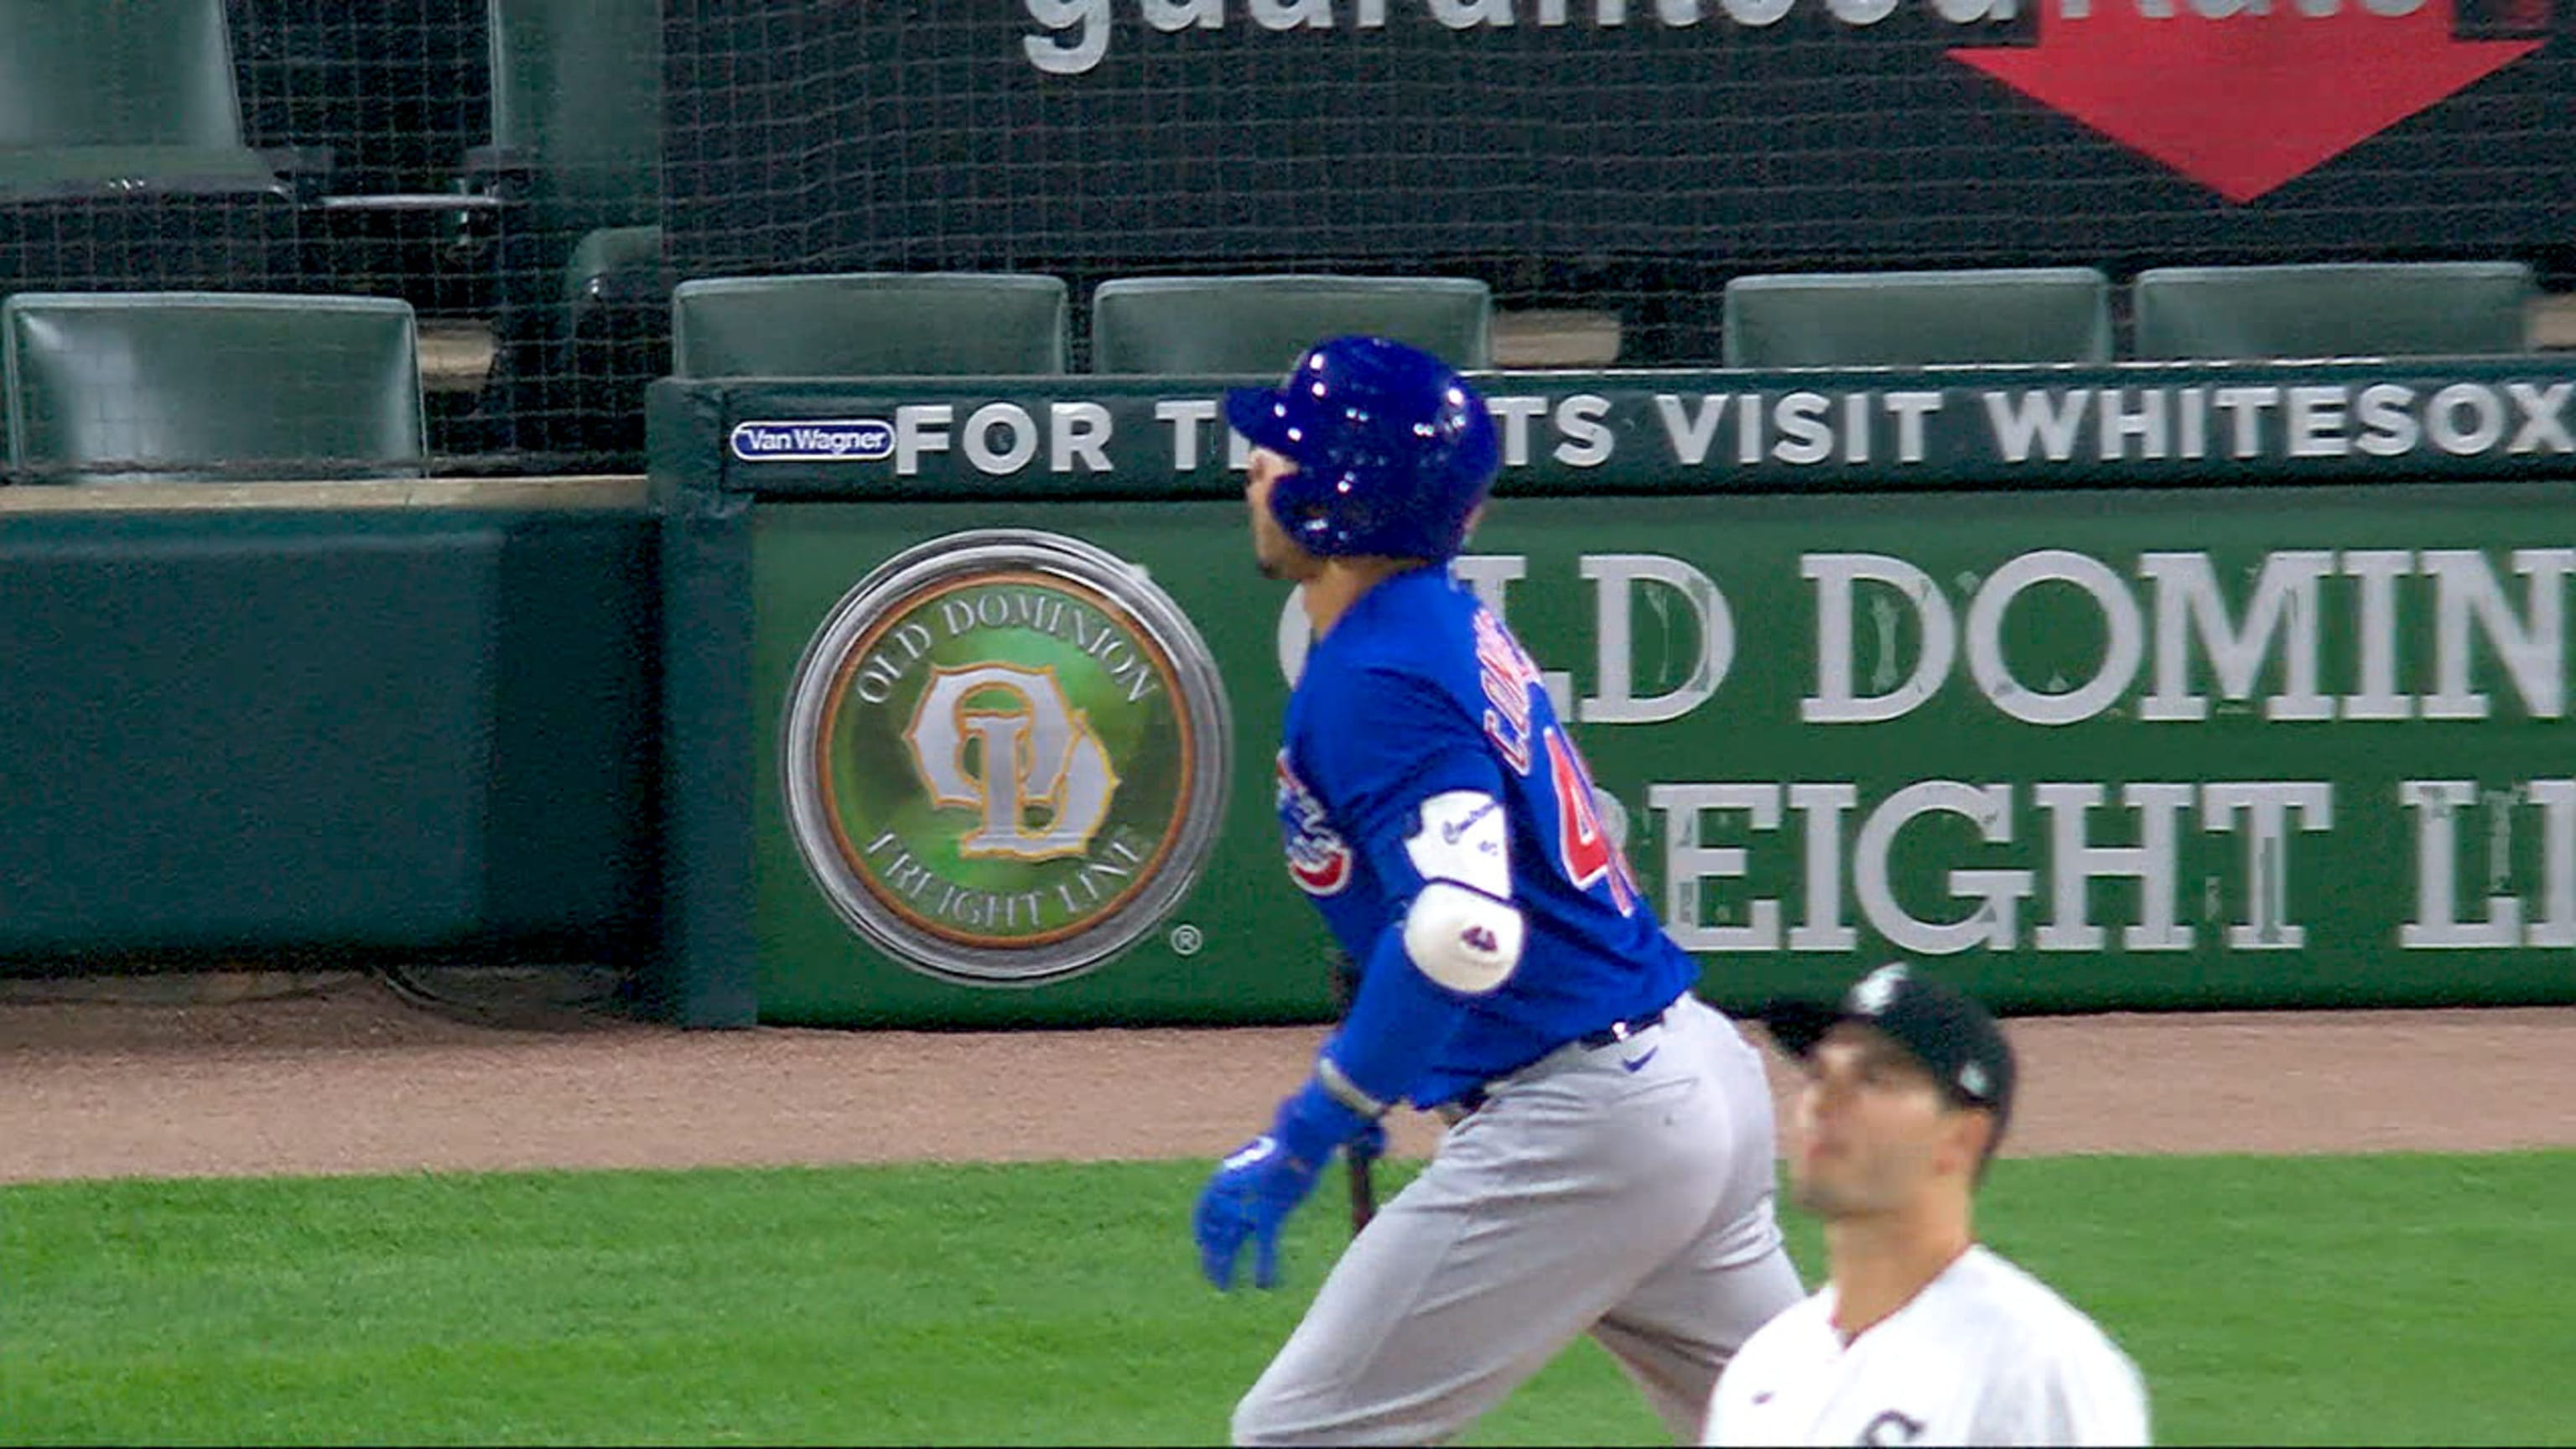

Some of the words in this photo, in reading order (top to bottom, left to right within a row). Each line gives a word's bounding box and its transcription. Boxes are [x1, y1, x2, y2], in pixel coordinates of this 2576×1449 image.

[738, 428, 792, 451] Van
[792, 428, 887, 456] Wagner
[894, 402, 1114, 475] FOR
[1653, 391, 1943, 465] VISIT
[1981, 382, 2576, 461] WHITESOX
[856, 622, 932, 704] OLD
[942, 593, 1158, 704] DOMINION
